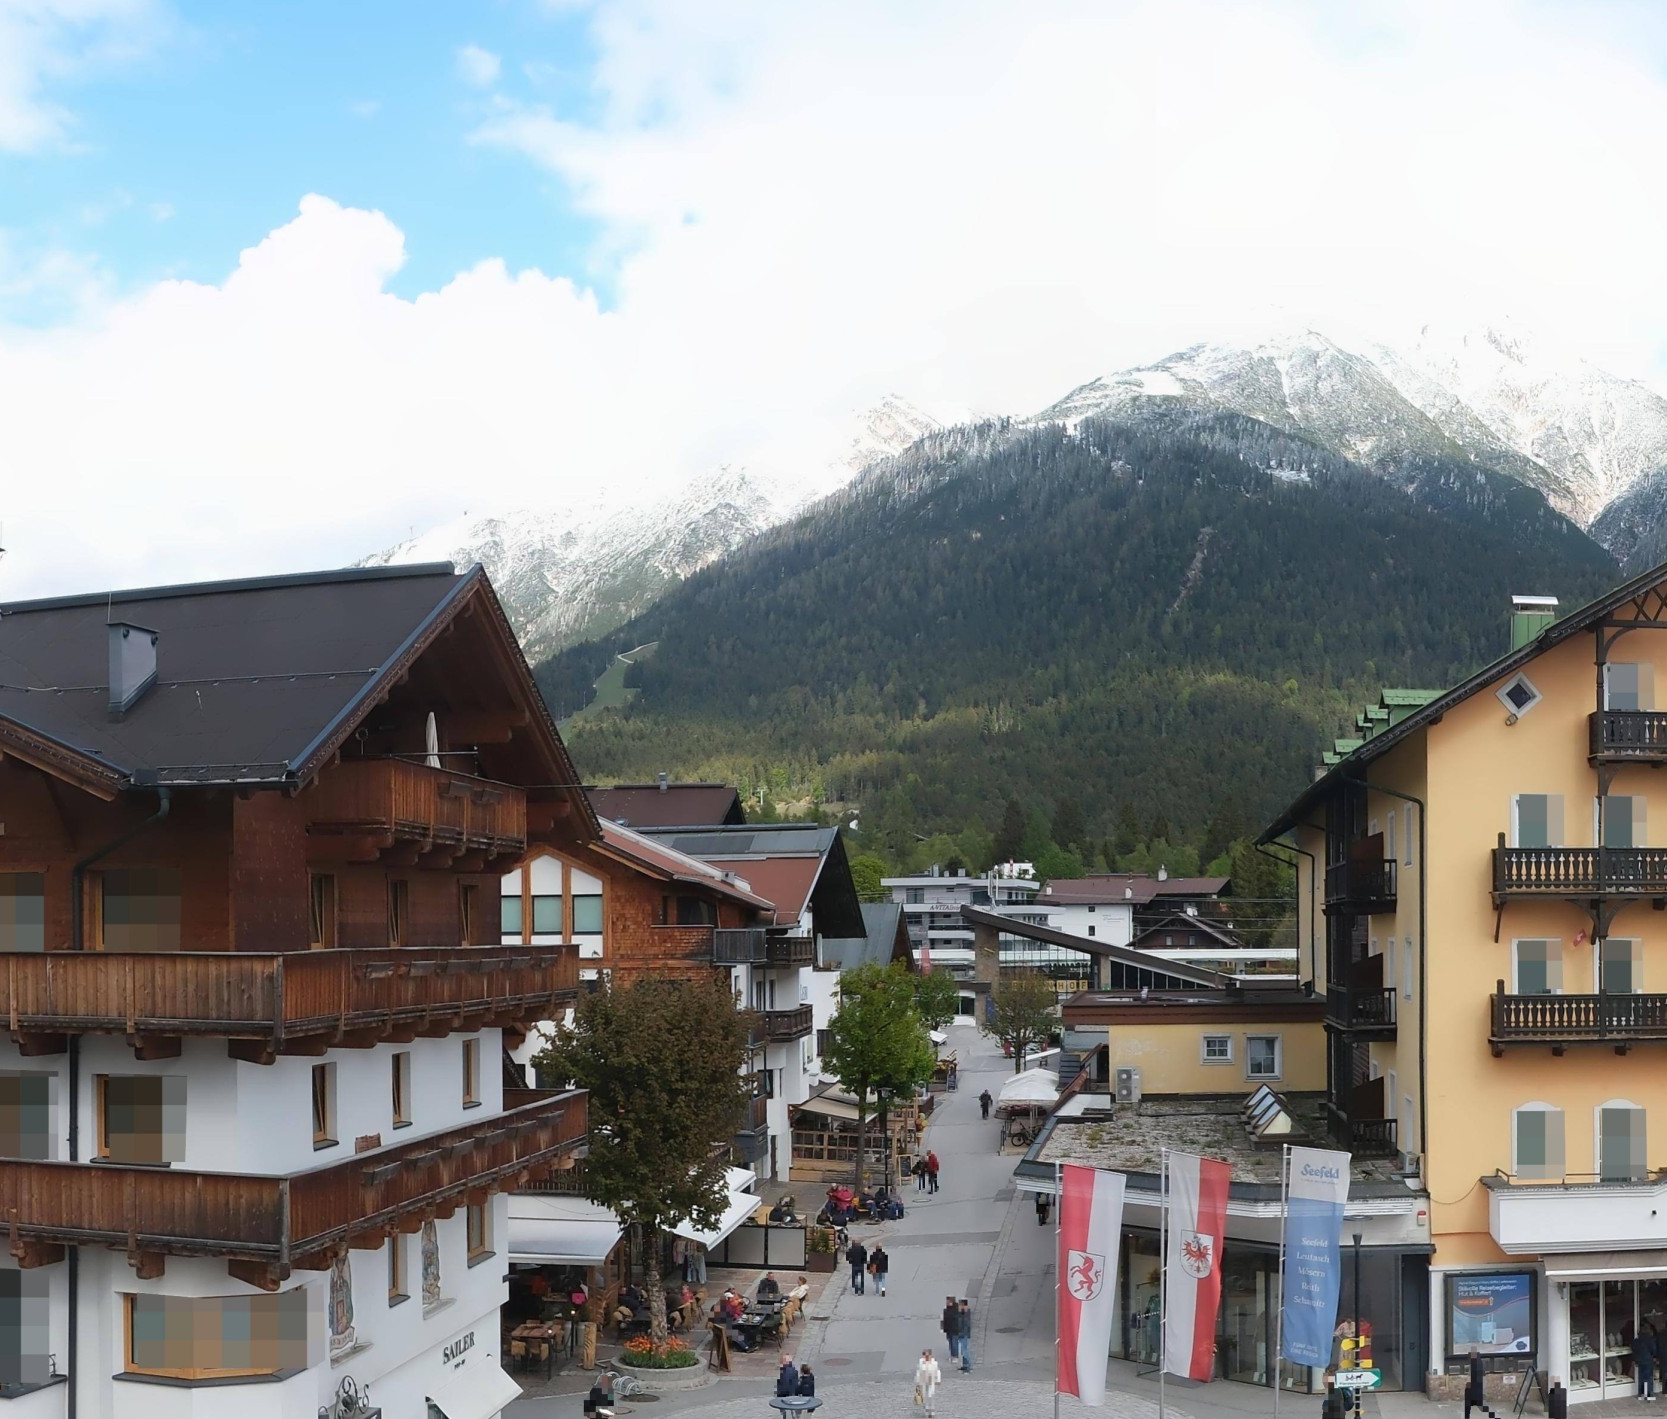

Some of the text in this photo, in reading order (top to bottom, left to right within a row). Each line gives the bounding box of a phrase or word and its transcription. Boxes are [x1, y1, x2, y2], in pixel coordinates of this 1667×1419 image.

[1300, 1163, 1340, 1180] Seefeld
[1301, 1236, 1329, 1248] Seefeld
[1296, 1251, 1330, 1264] Leutasch
[443, 1331, 476, 1365] SAILER
